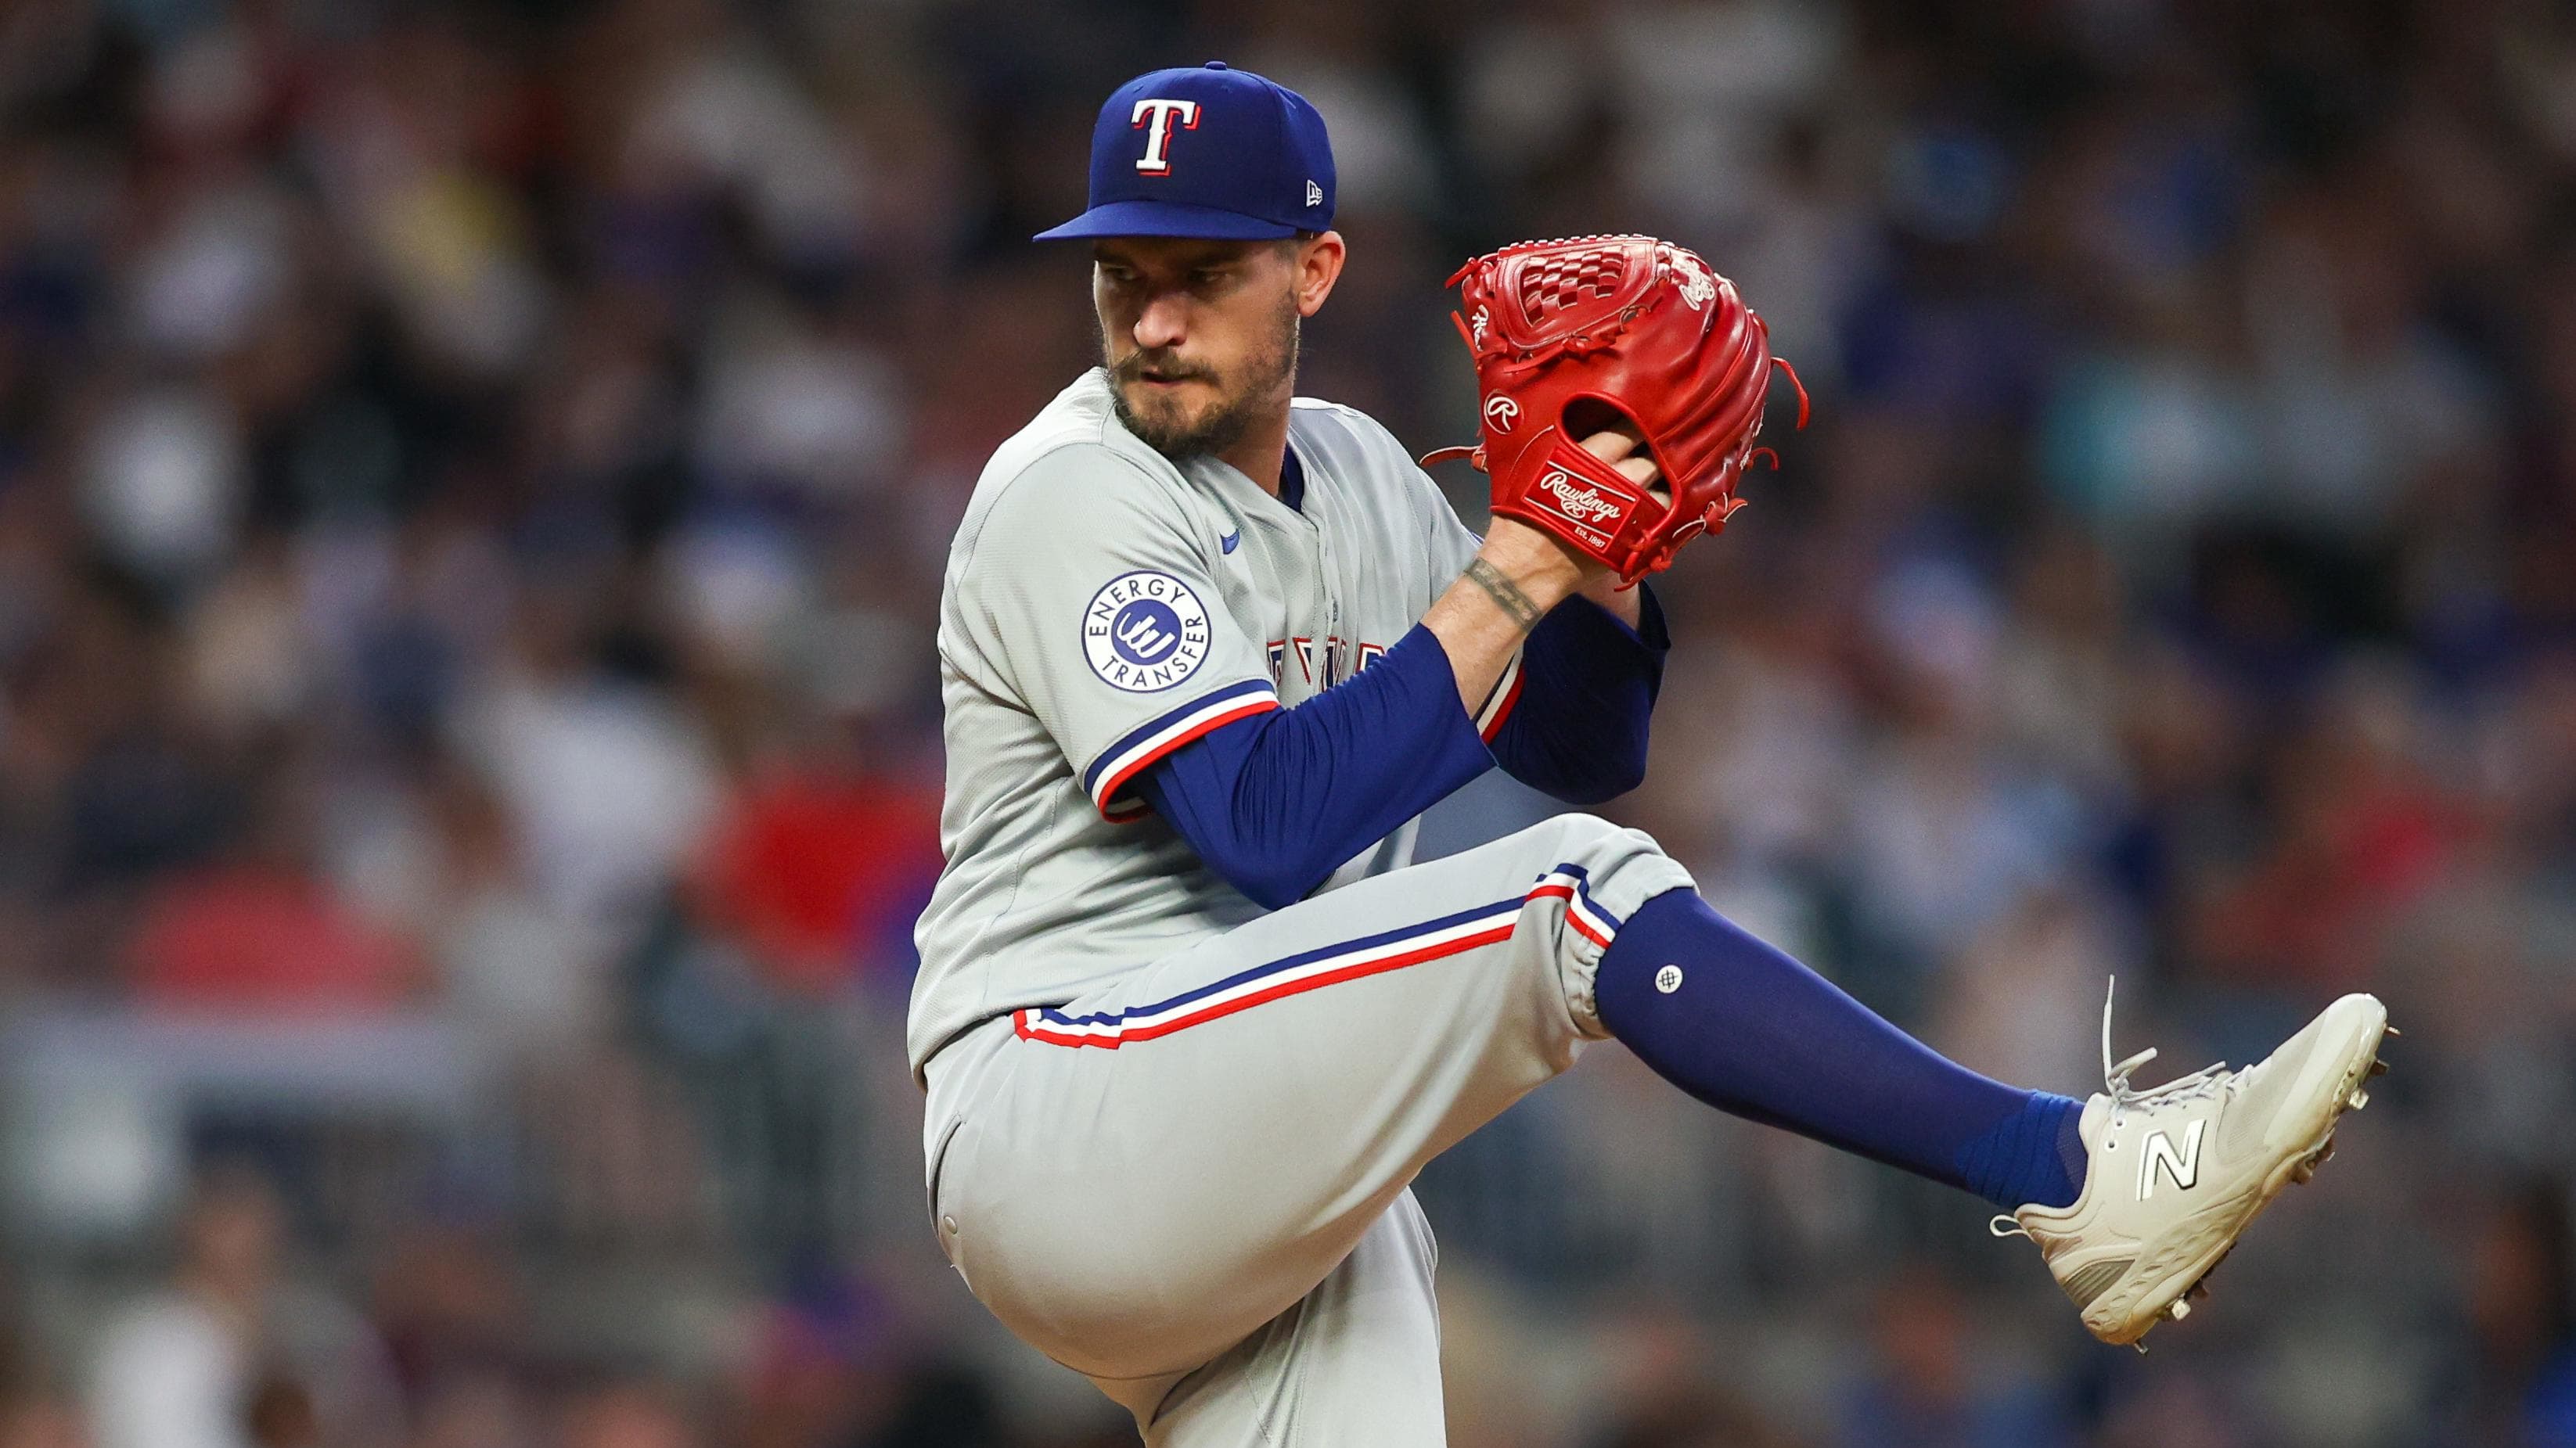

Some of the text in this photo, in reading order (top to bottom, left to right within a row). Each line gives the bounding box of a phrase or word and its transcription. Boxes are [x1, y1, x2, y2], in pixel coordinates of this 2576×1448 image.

[1131, 99, 1201, 176] T
[1488, 397, 1518, 431] R
[1541, 471, 1621, 523] Rawlings
[1089, 579, 1185, 636] ENERGY
[1103, 616, 1204, 687] TRANSFER
[2136, 1119, 2207, 1202] N
